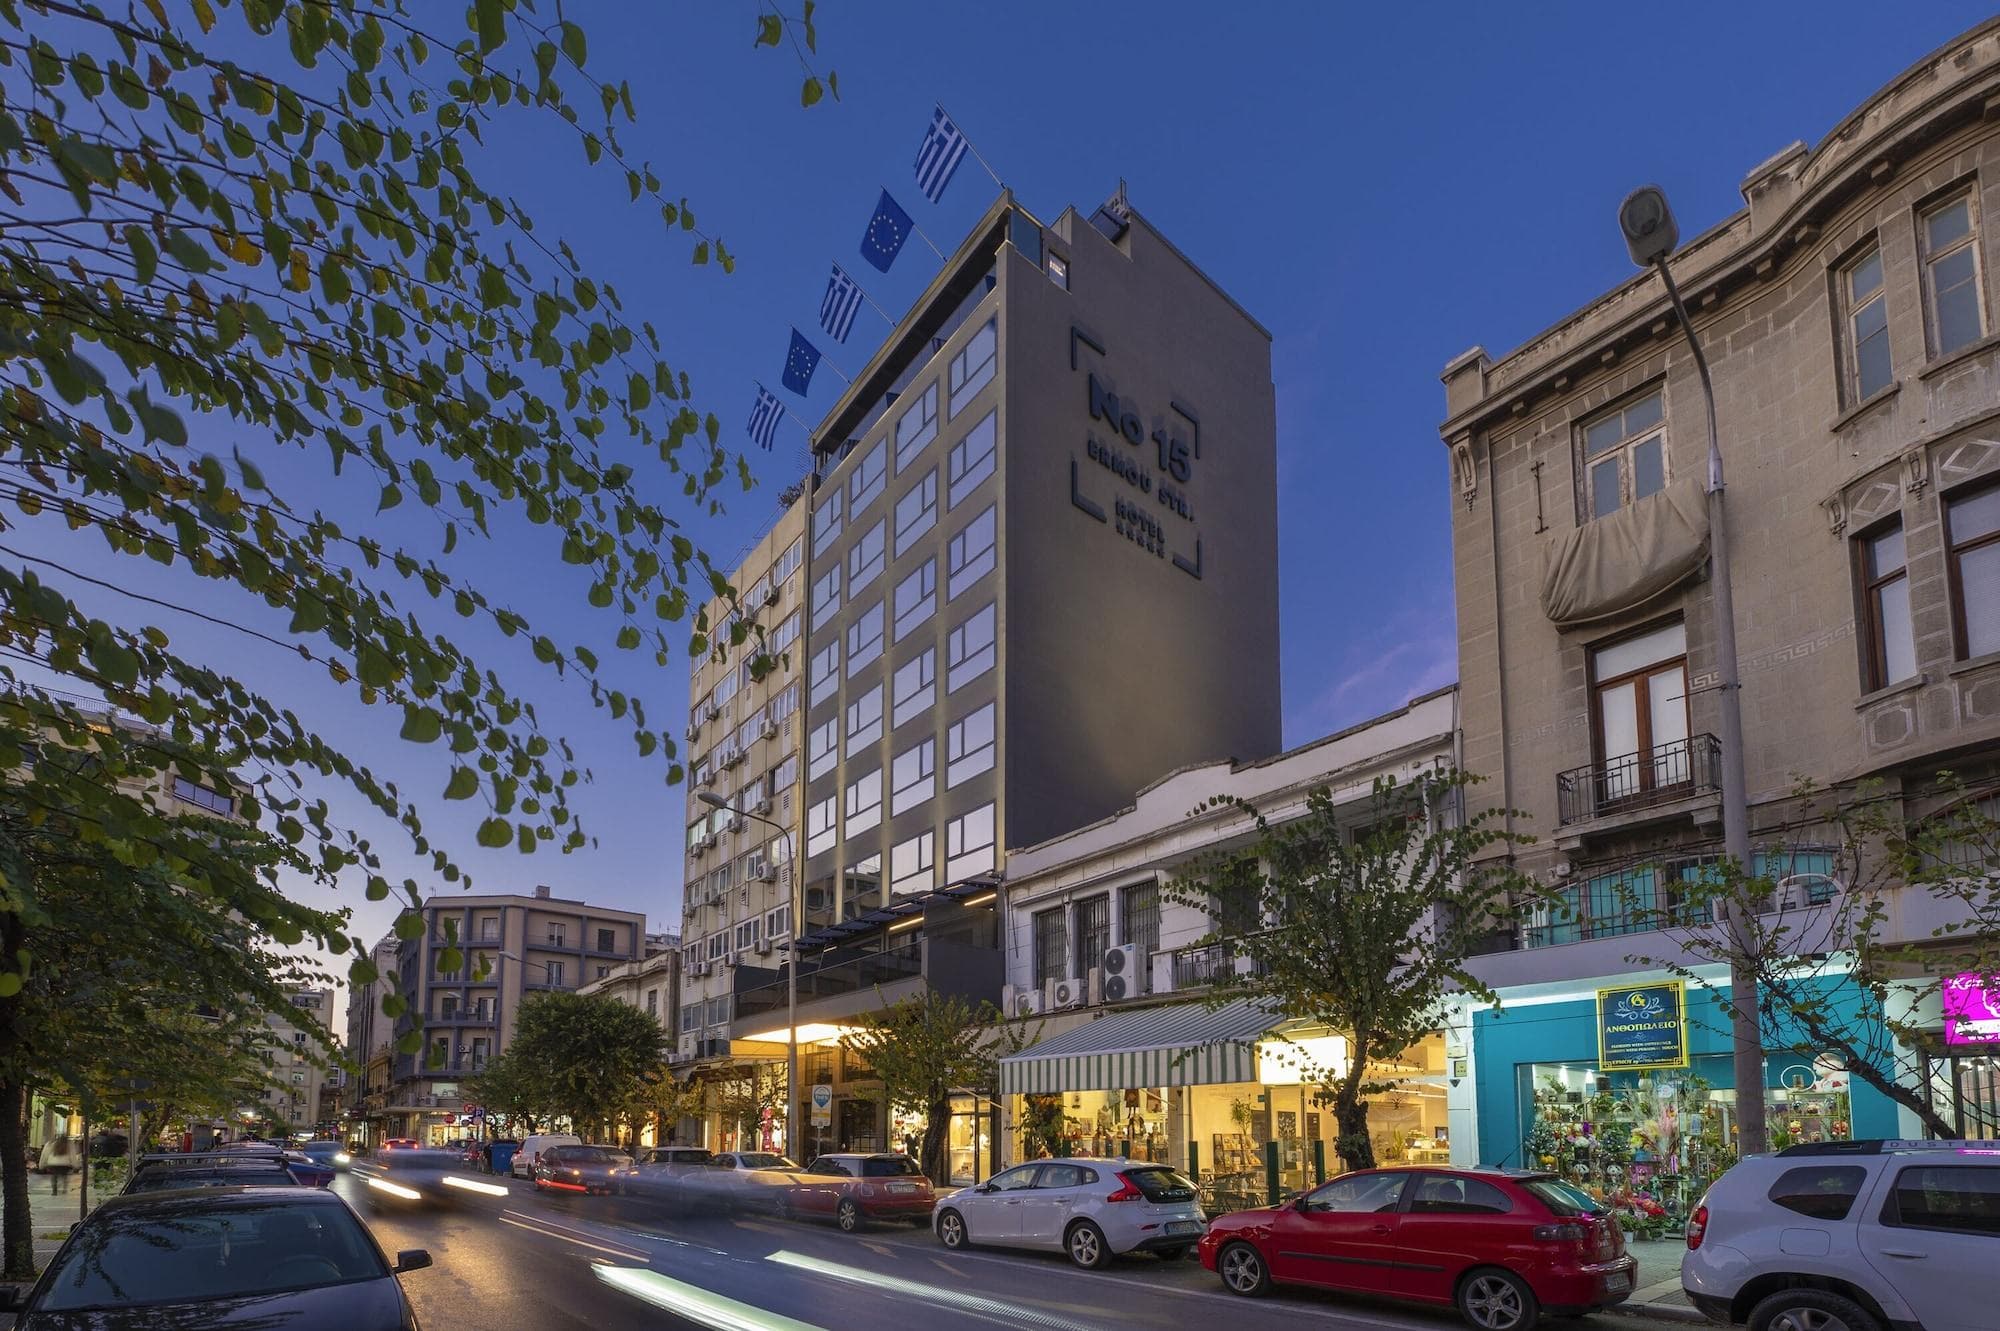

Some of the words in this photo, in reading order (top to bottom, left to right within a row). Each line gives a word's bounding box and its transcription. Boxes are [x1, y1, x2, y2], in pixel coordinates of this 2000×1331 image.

[1089, 372, 1144, 446] No
[1152, 426, 1192, 483] 15
[1087, 435, 1151, 494] ERMOU
[1115, 499, 1165, 543] HOTEL
[1606, 1020, 1676, 1033] ΑΝΘΟΠΩΛΕΙΟ
